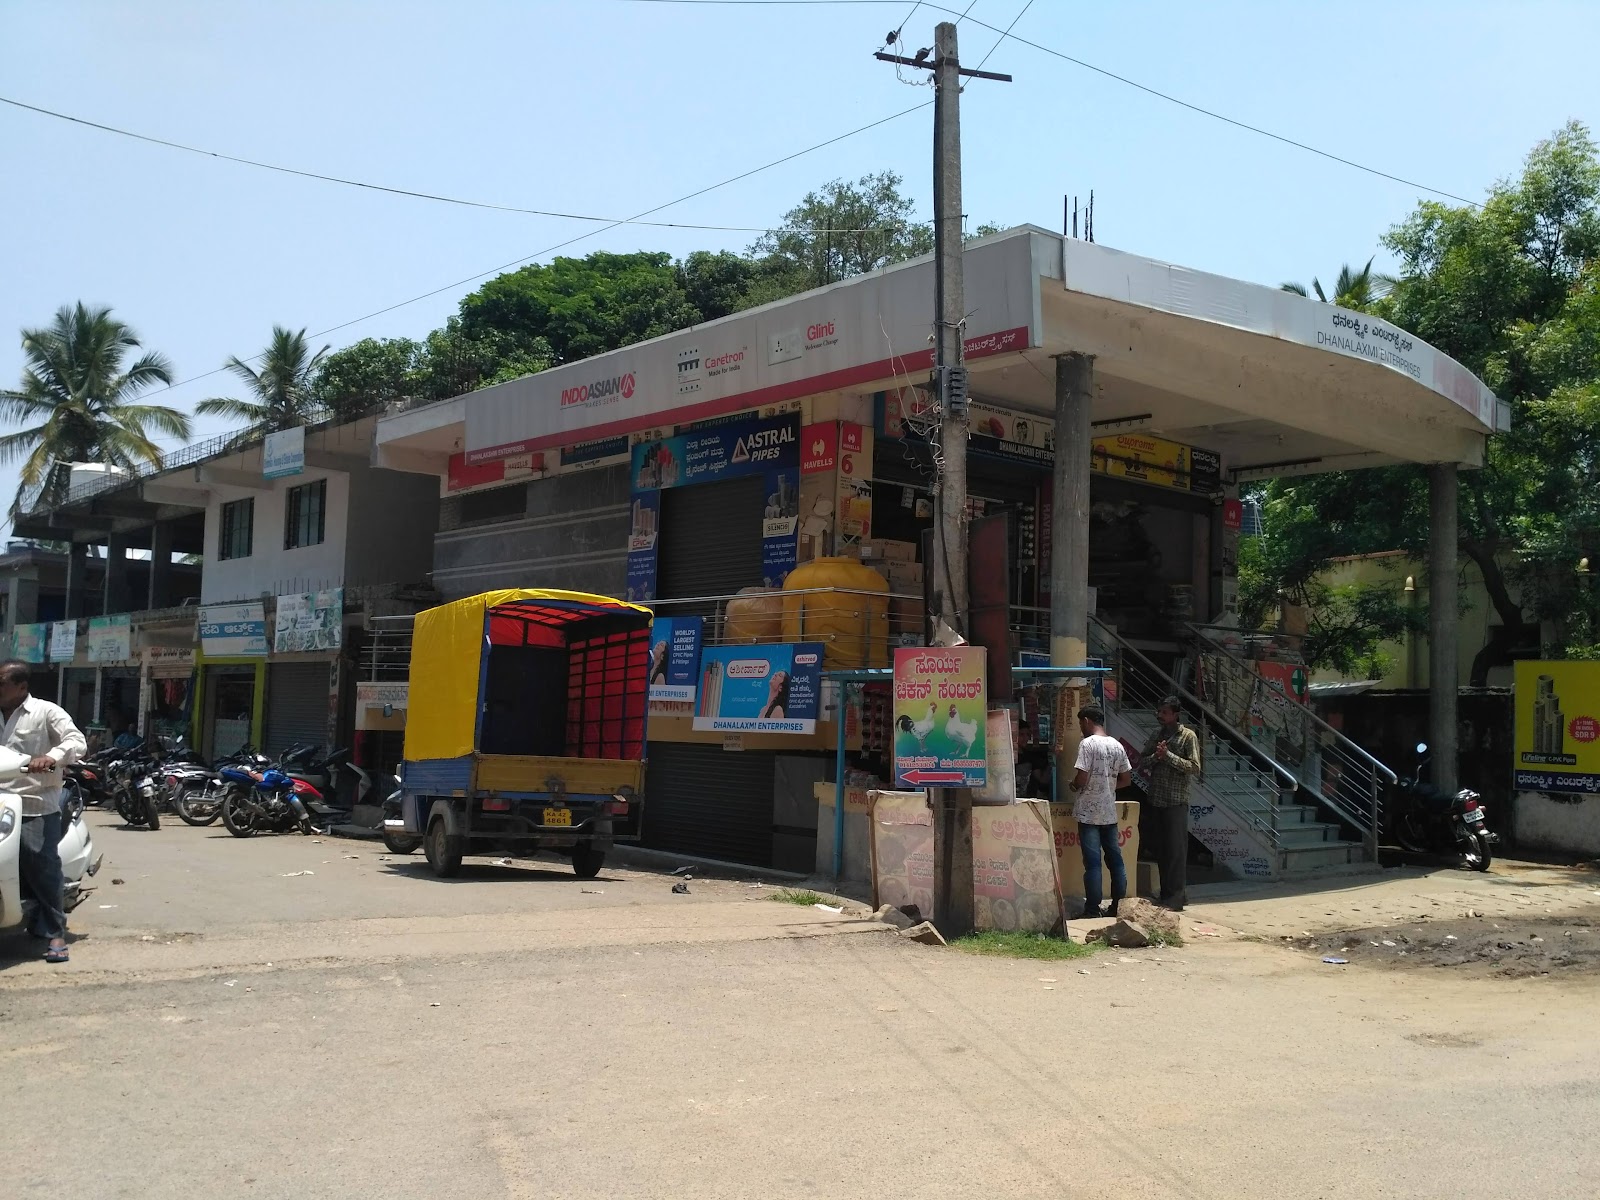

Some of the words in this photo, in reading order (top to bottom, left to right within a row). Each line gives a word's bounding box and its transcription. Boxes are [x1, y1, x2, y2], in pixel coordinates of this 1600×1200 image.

[806, 321, 835, 341] Glint
[822, 338, 839, 346] Change
[704, 351, 744, 369] Caretron
[1317, 331, 1378, 358] DHANALAXMI
[1380, 348, 1421, 378] ENTERPRISES
[708, 369, 721, 377] Made
[729, 364, 741, 373] India
[560, 376, 621, 406] INDOASIAN
[968, 403, 981, 411] more
[981, 405, 995, 414] short
[995, 408, 1012, 417] circuits
[731, 413, 753, 422] CHOICE
[746, 425, 796, 450] ASTRAL
[498, 444, 526, 457] ENTERPRISES
[843, 443, 860, 451] HAVELLS
[751, 447, 780, 462] PIPES
[804, 457, 833, 470] HAVELLS
[841, 454, 853, 475] 6
[1042, 503, 1051, 558] HAVELLS
[655, 690, 688, 698] ENTERPRISES
[895, 678, 932, 700] ಚಿಕನ್
[713, 721, 757, 730] DHANALAXMI
[757, 722, 804, 731] ENTERPRISES
